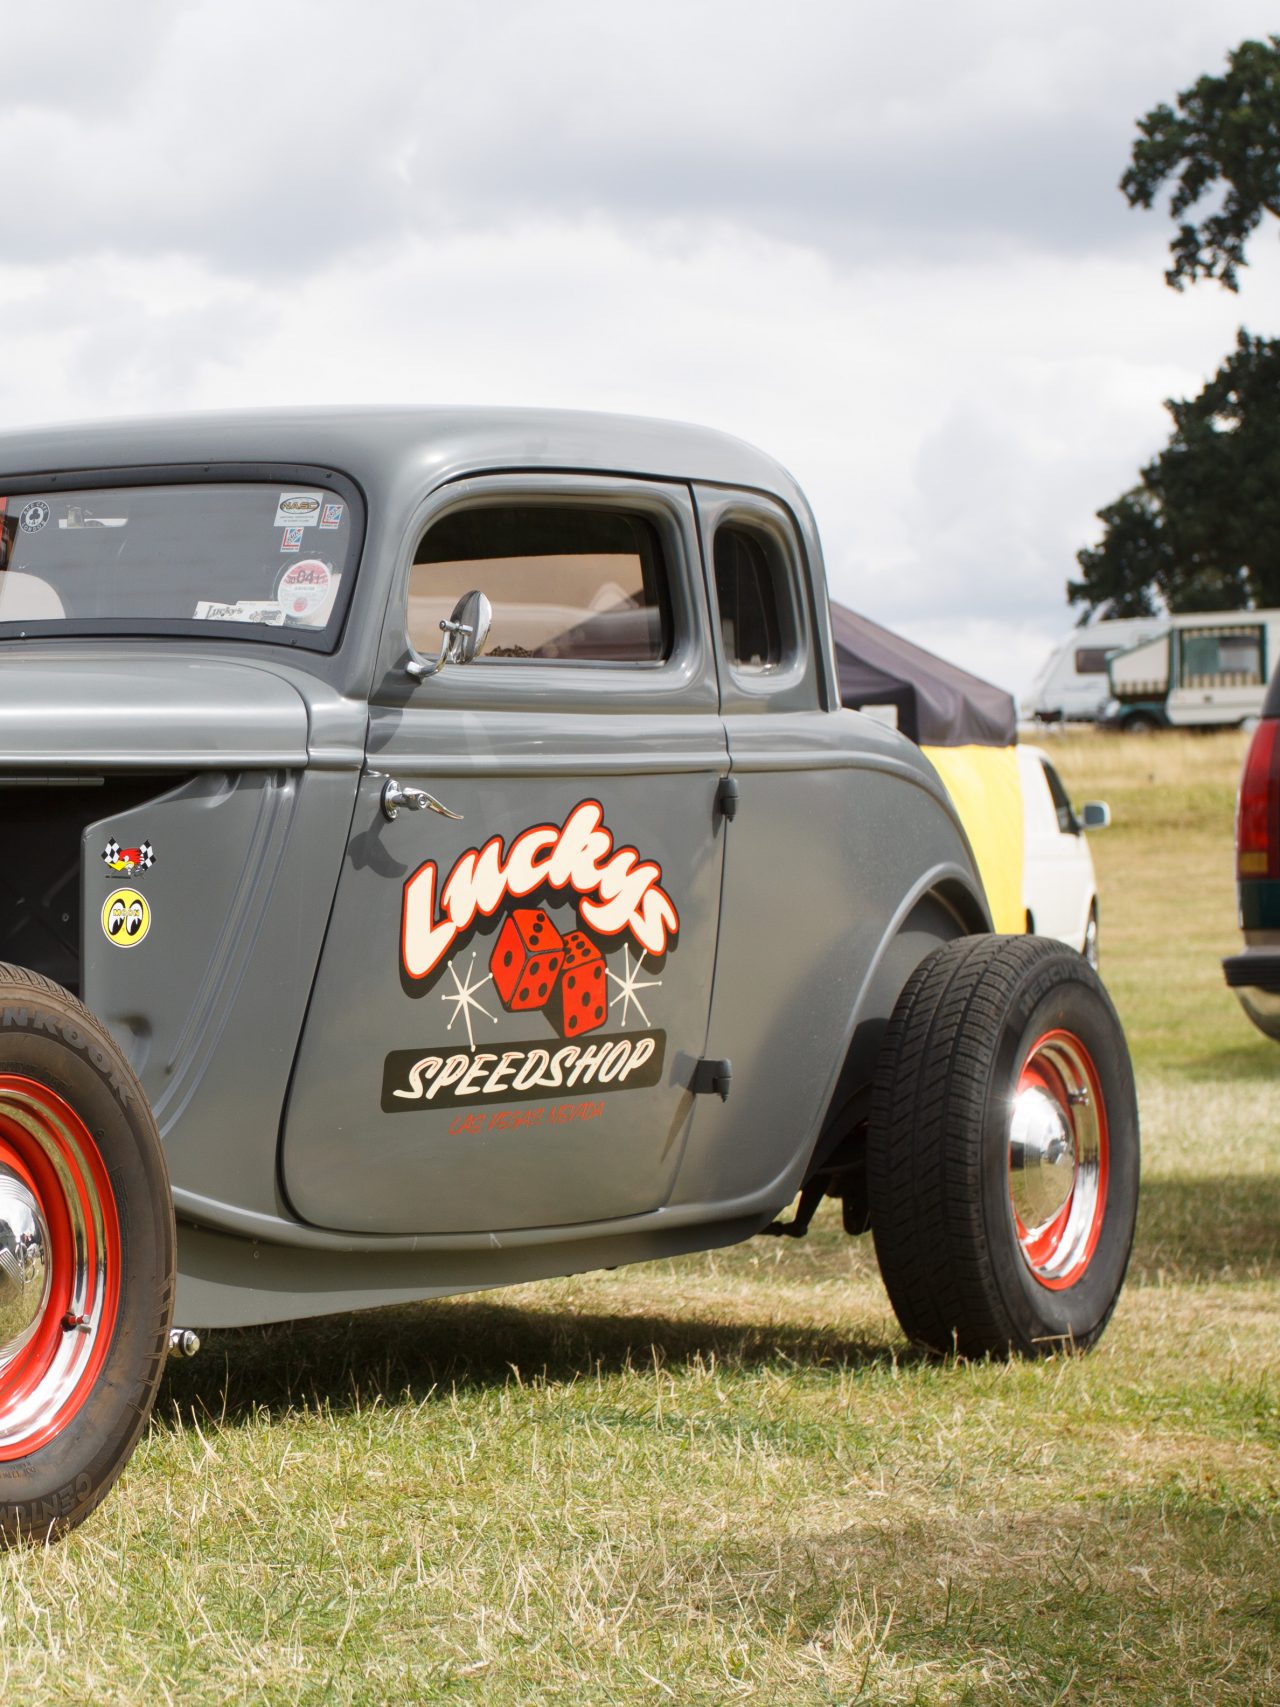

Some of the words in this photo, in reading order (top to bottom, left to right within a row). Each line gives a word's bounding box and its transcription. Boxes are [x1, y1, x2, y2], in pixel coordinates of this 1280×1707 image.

[113, 908, 140, 917] MOON
[402, 799, 680, 979] Luckys
[393, 1038, 656, 1100] SPEEDSHOP
[447, 1111, 485, 1136] LAS
[487, 1107, 545, 1132] VEGAS
[547, 1100, 606, 1124] NEVADA
